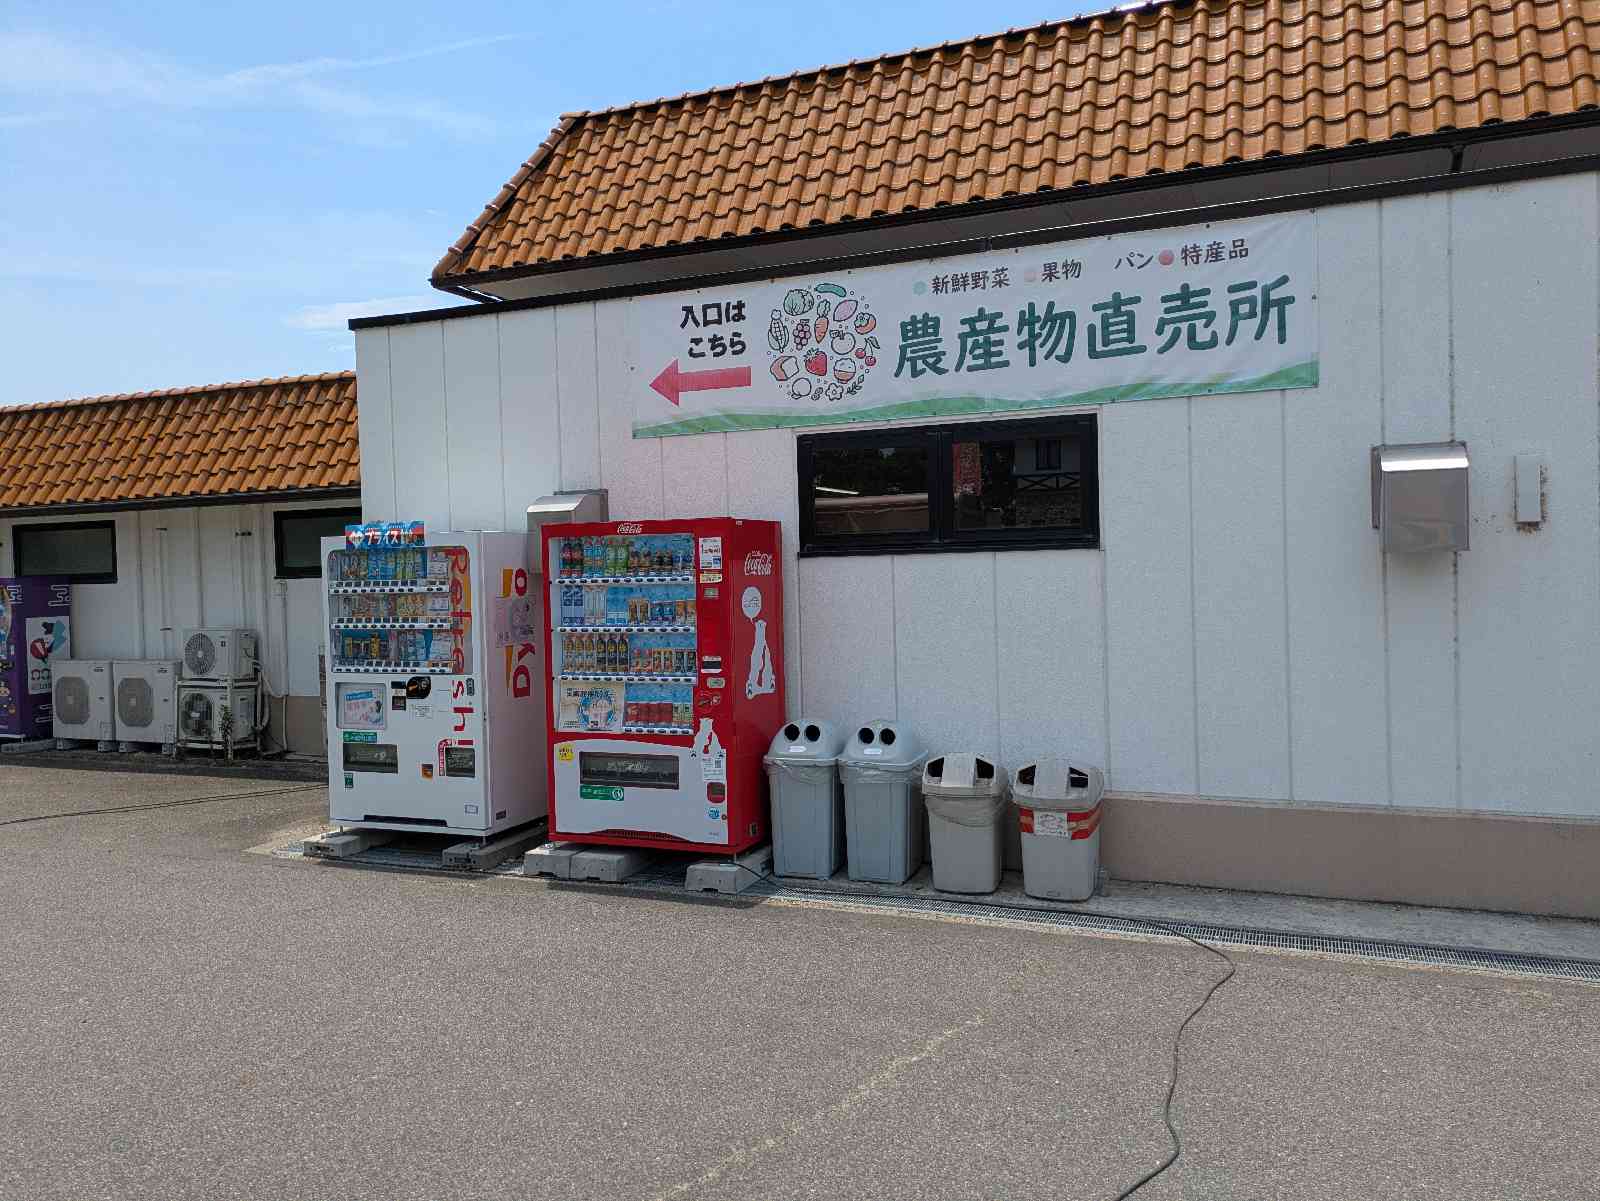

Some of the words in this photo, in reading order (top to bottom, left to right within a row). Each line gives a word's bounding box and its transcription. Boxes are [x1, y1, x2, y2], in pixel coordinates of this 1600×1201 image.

[931, 267, 1010, 295] 新鮮野菜
[1040, 258, 1082, 283] 果物
[1114, 251, 1154, 270] パン
[1180, 238, 1250, 267] 特産品
[679, 300, 746, 329] 入口は
[893, 274, 1296, 379] 農産物直売所
[687, 331, 747, 358] こちら
